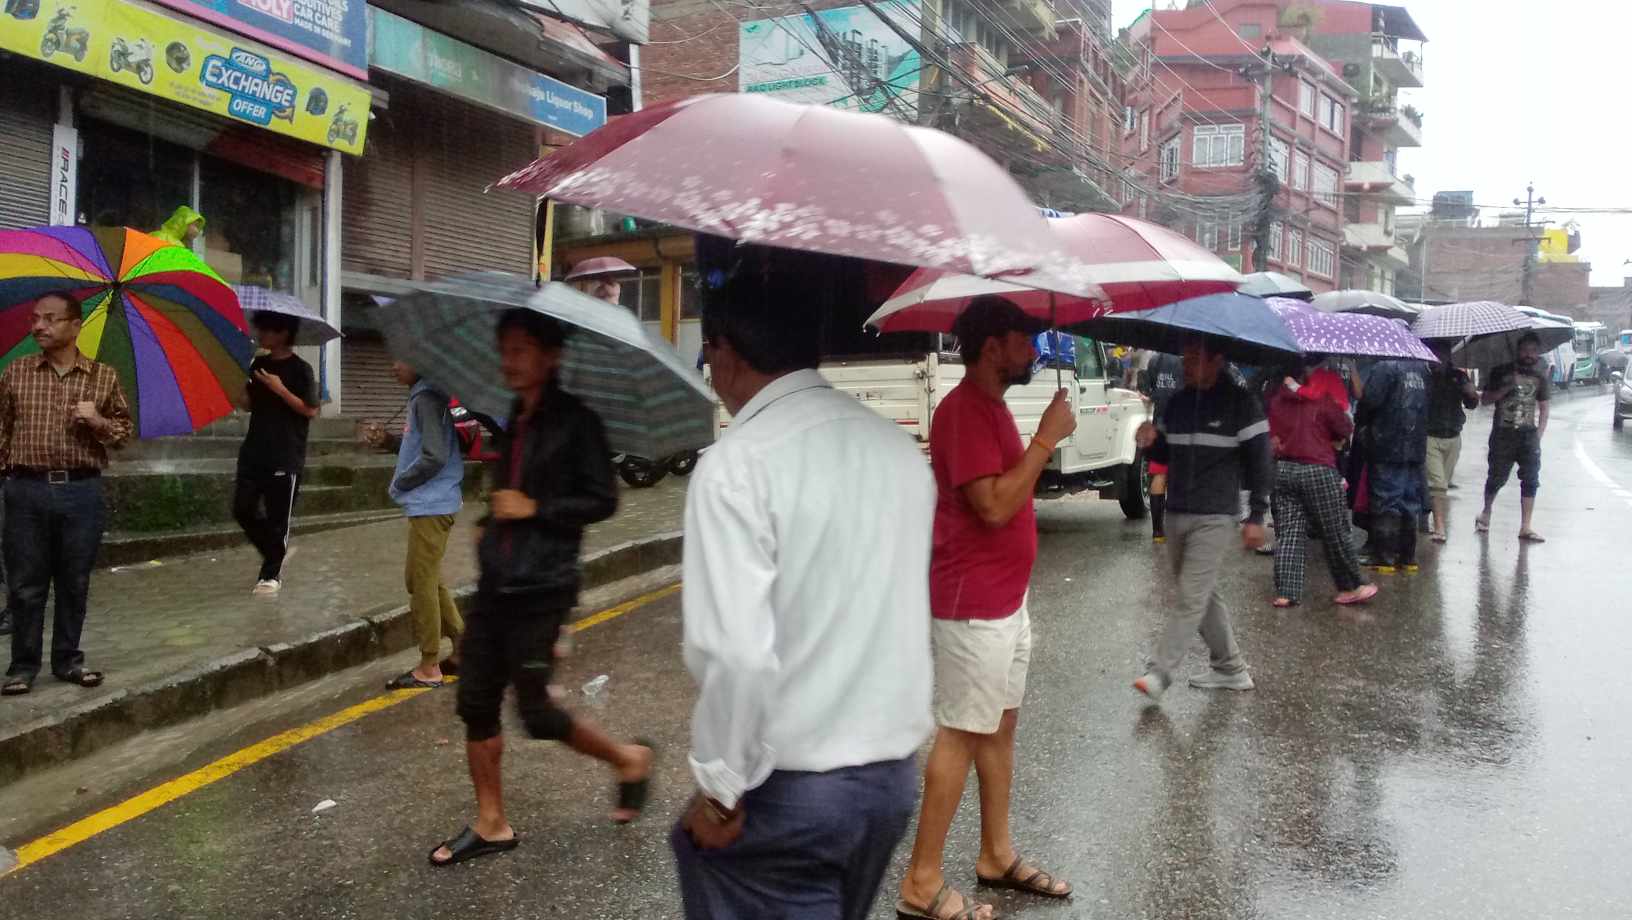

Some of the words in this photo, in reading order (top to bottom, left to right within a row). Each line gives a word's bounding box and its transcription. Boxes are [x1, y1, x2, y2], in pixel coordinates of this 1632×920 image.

[294, 3, 314, 21] CAR
[206, 60, 294, 106] EXCHANGE
[233, 99, 266, 118] OFFER
